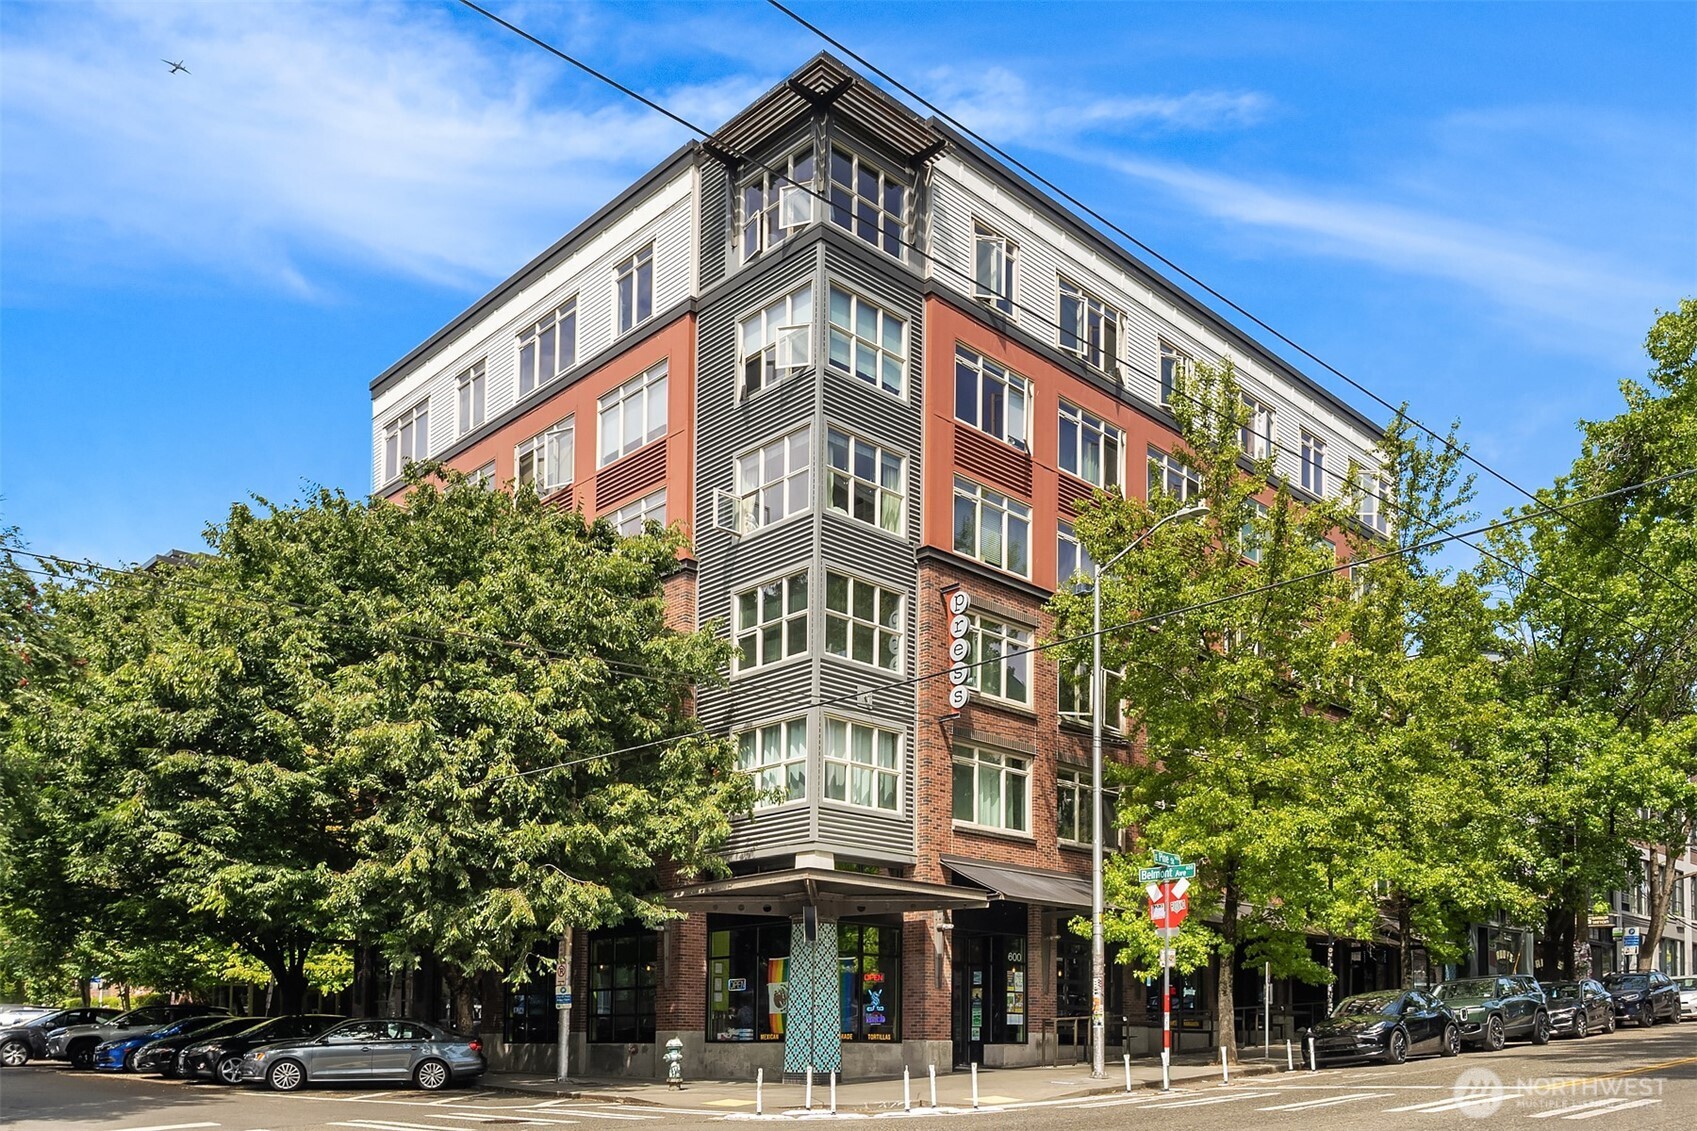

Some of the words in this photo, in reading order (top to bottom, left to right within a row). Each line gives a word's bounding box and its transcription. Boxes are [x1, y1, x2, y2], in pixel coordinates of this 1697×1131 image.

[953, 594, 965, 703] press
[1141, 868, 1173, 880] Belmont
[1007, 952, 1022, 962] 600
[863, 973, 884, 982] OPEN
[730, 979, 746, 990] OPEN
[760, 1033, 779, 1041] MEXICAN
[867, 1033, 891, 1041] TORTILLAS
